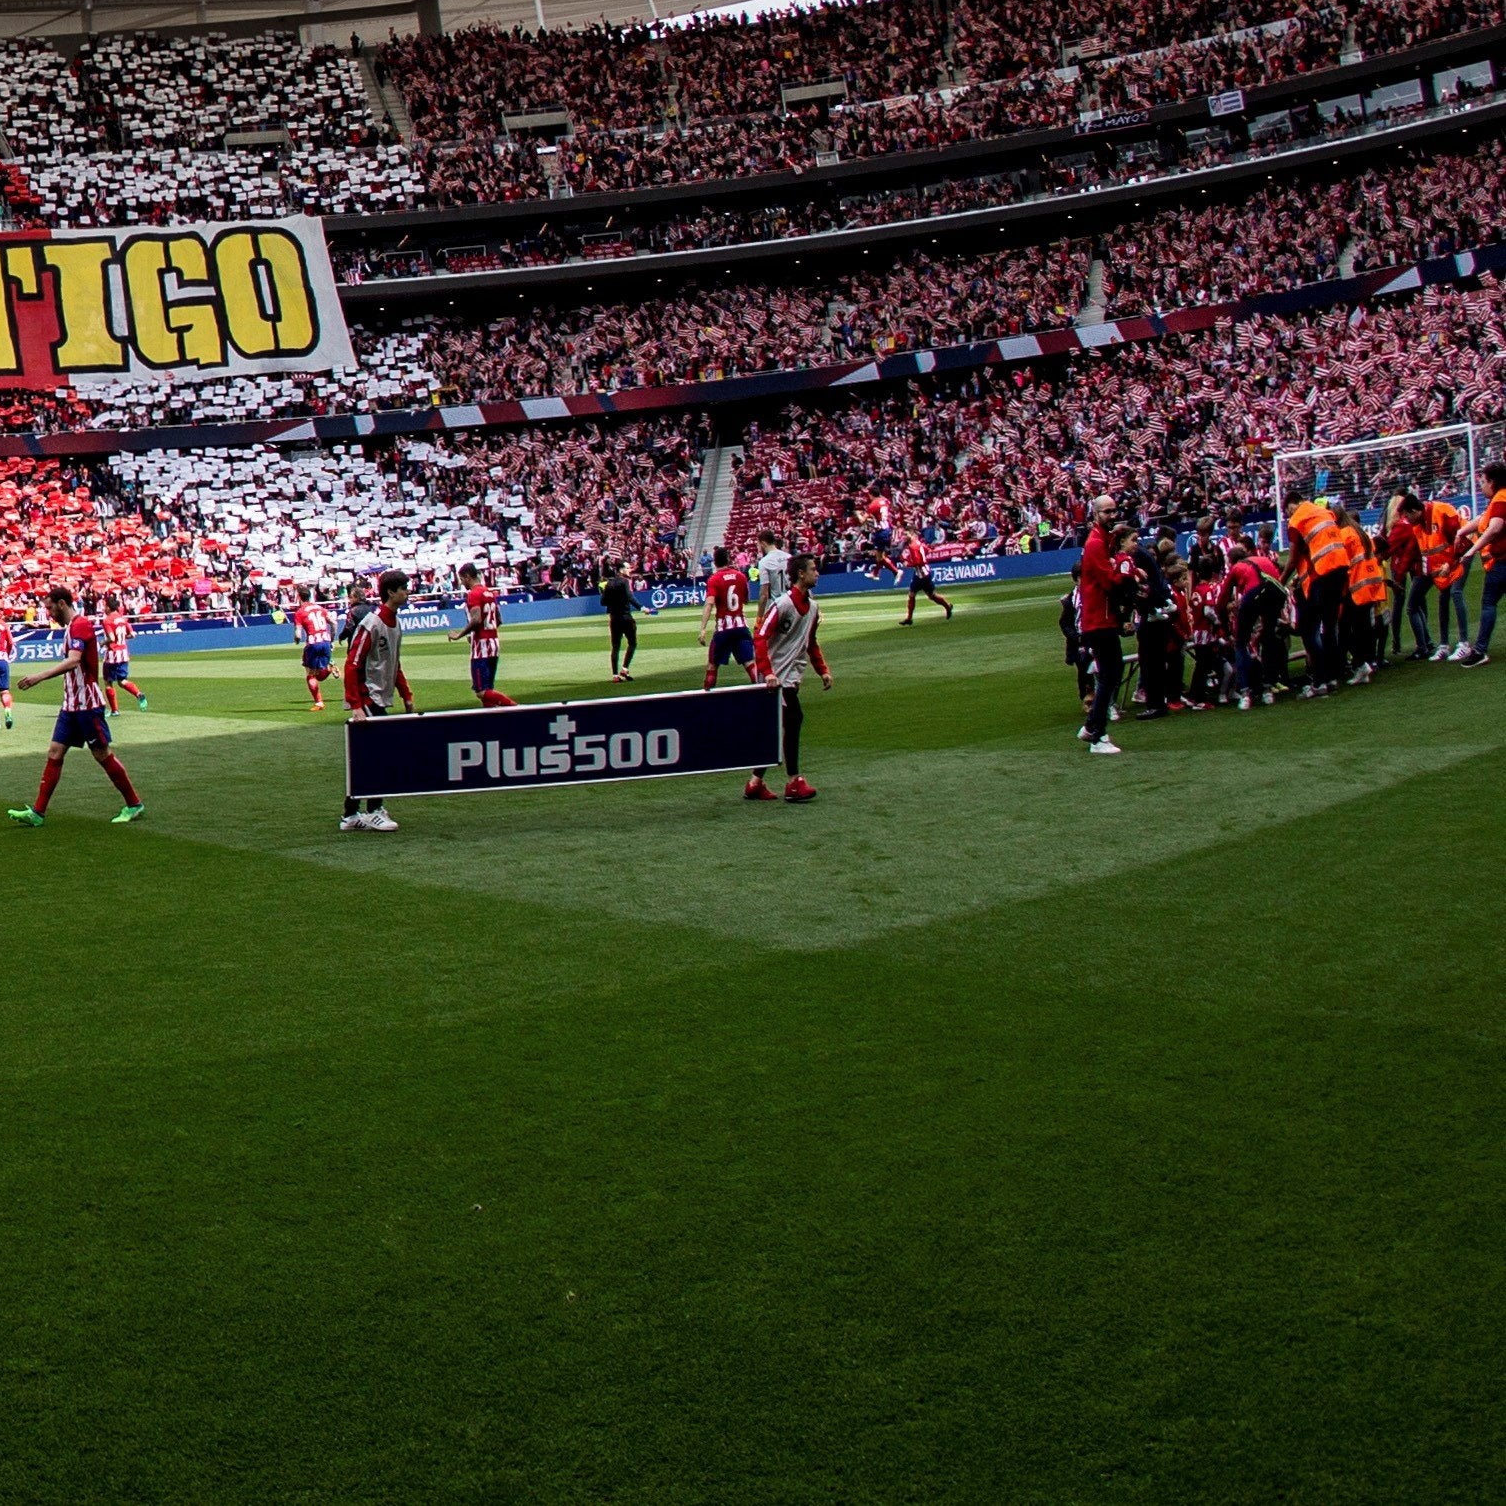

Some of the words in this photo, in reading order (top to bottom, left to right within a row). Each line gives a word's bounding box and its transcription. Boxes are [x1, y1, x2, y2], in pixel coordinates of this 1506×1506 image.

[726, 584, 739, 612] 6
[308, 610, 328, 632] 16
[447, 728, 680, 781] Plus500
